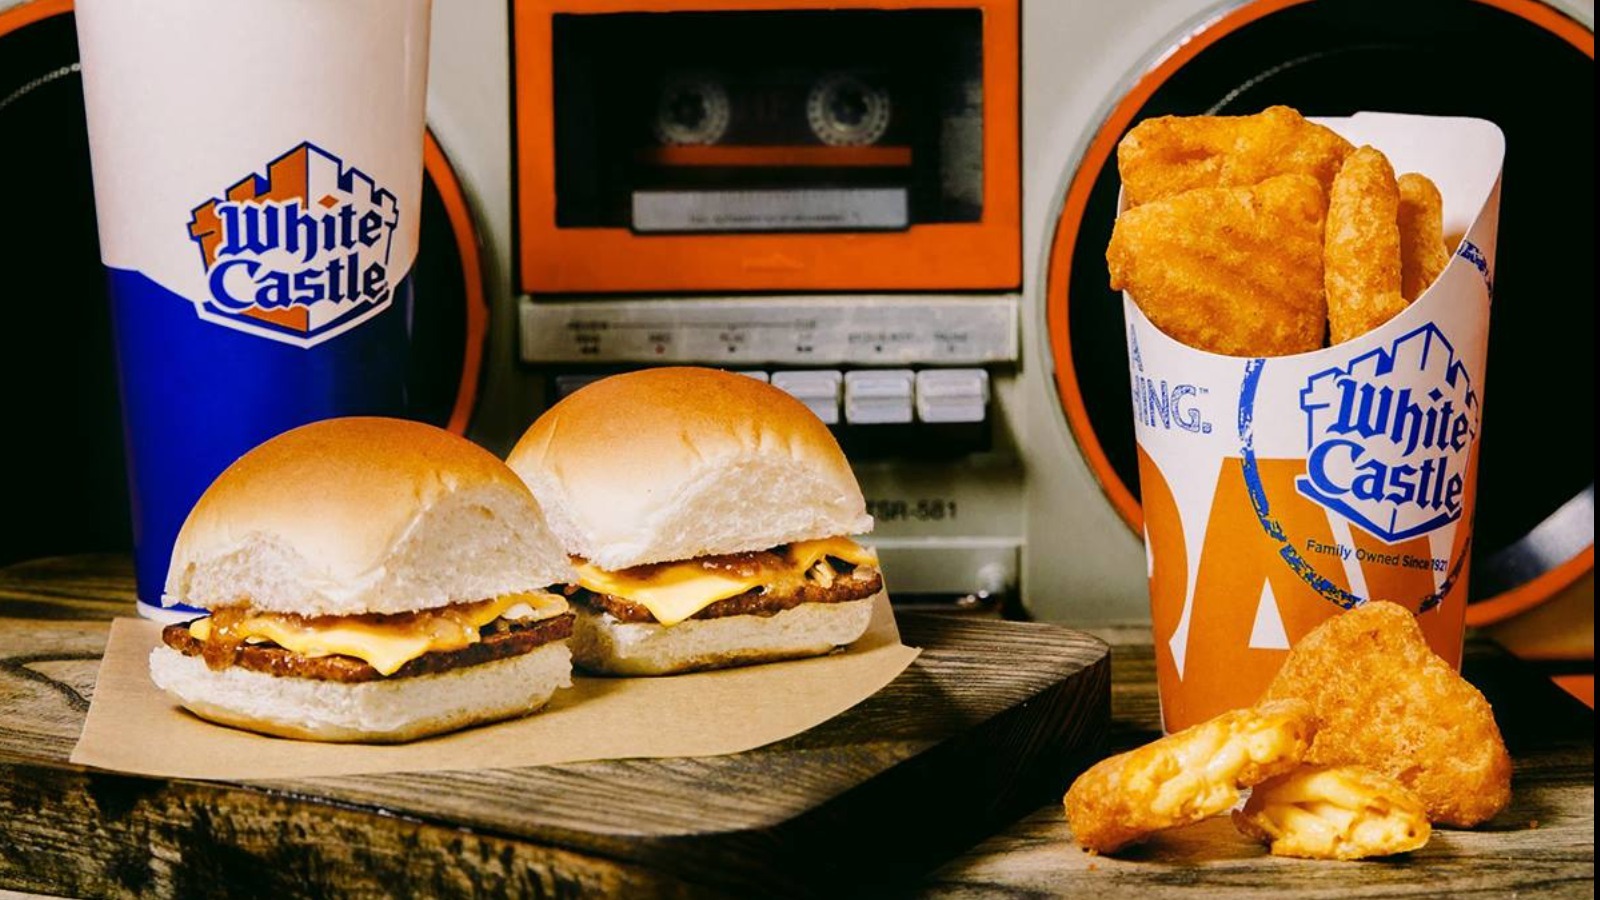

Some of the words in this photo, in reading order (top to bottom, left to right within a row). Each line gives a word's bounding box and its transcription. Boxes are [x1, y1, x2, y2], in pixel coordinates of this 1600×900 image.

[217, 194, 383, 263] White
[208, 251, 387, 310] Castle
[1325, 377, 1469, 457] White
[1308, 438, 1463, 513] Castle
[1306, 539, 1352, 561] Family
[1355, 547, 1399, 567] Owned
[1401, 555, 1430, 570] Since
